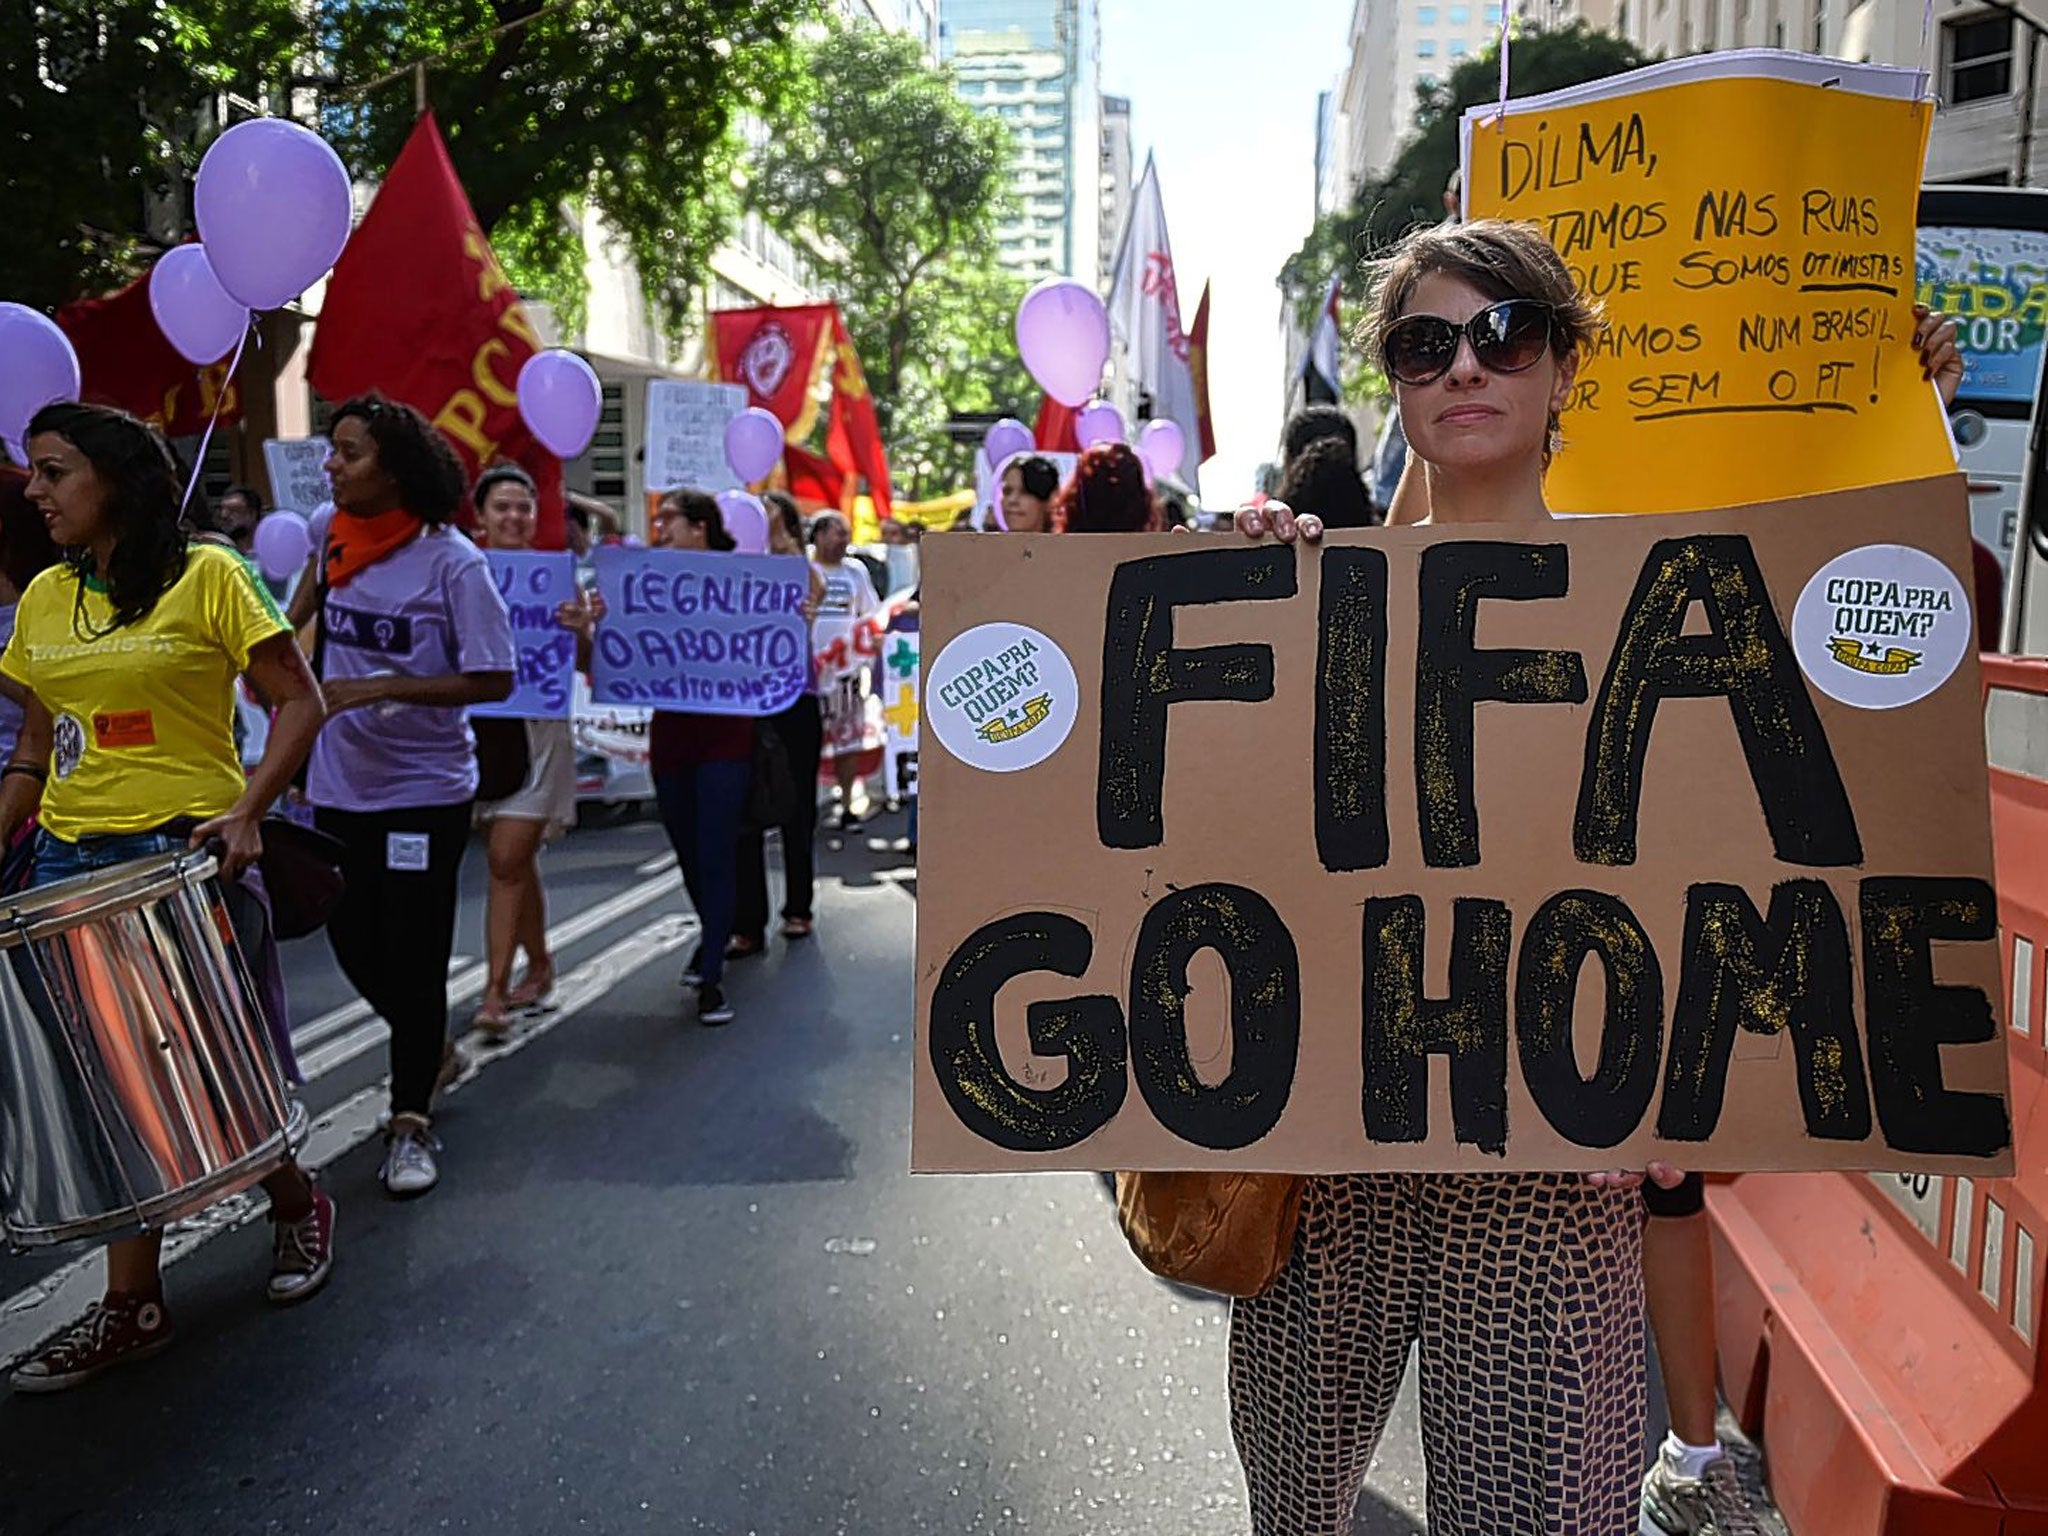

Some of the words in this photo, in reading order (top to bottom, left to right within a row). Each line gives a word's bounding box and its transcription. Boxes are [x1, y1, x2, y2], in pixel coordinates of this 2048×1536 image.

[1500, 112, 1658, 202] DILMA,
[1503, 202, 1668, 258] TAMOS
[1693, 190, 1778, 241] NAS
[1802, 189, 1879, 237] RUAS
[1672, 250, 1791, 290] SOMOS
[1802, 250, 1903, 282] OTIMISTAS
[1738, 313, 1800, 352] NUM
[1811, 308, 1897, 342] BRASIL
[1627, 370, 1721, 408] SEM
[1768, 369, 1797, 400] O
[1826, 578, 1902, 608] COPA
[1903, 588, 1953, 612] PRA
[1834, 607, 1935, 638] QUEM?
[939, 658, 1004, 708] COPA
[996, 638, 1039, 670] PRA
[963, 660, 1039, 724] QUEM?
[1097, 534, 1865, 872] FIFA
[928, 882, 1300, 1152] GO
[1361, 876, 2012, 1156] HOME
